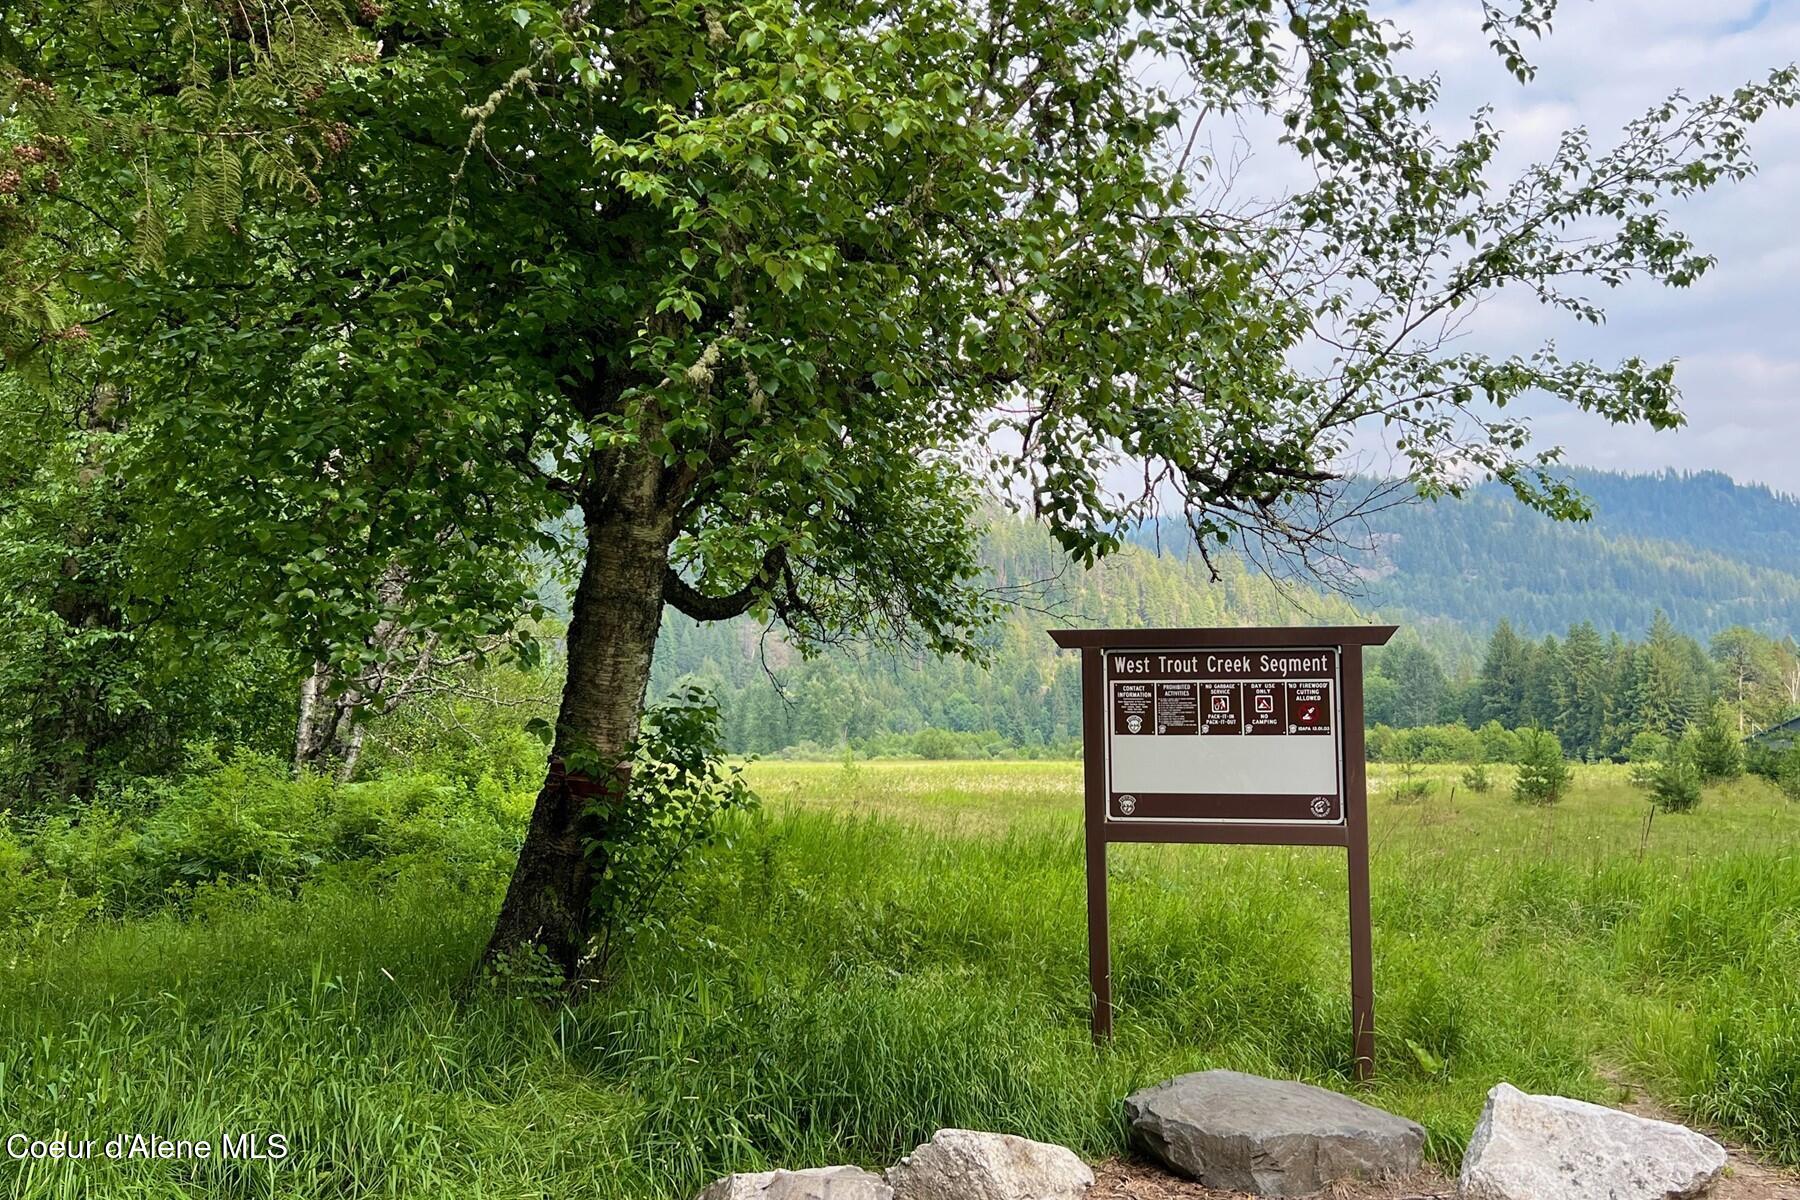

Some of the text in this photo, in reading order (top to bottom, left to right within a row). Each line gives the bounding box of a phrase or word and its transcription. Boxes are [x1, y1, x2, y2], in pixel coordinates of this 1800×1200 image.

[1115, 655, 1328, 677] West Trout Creek Segment
